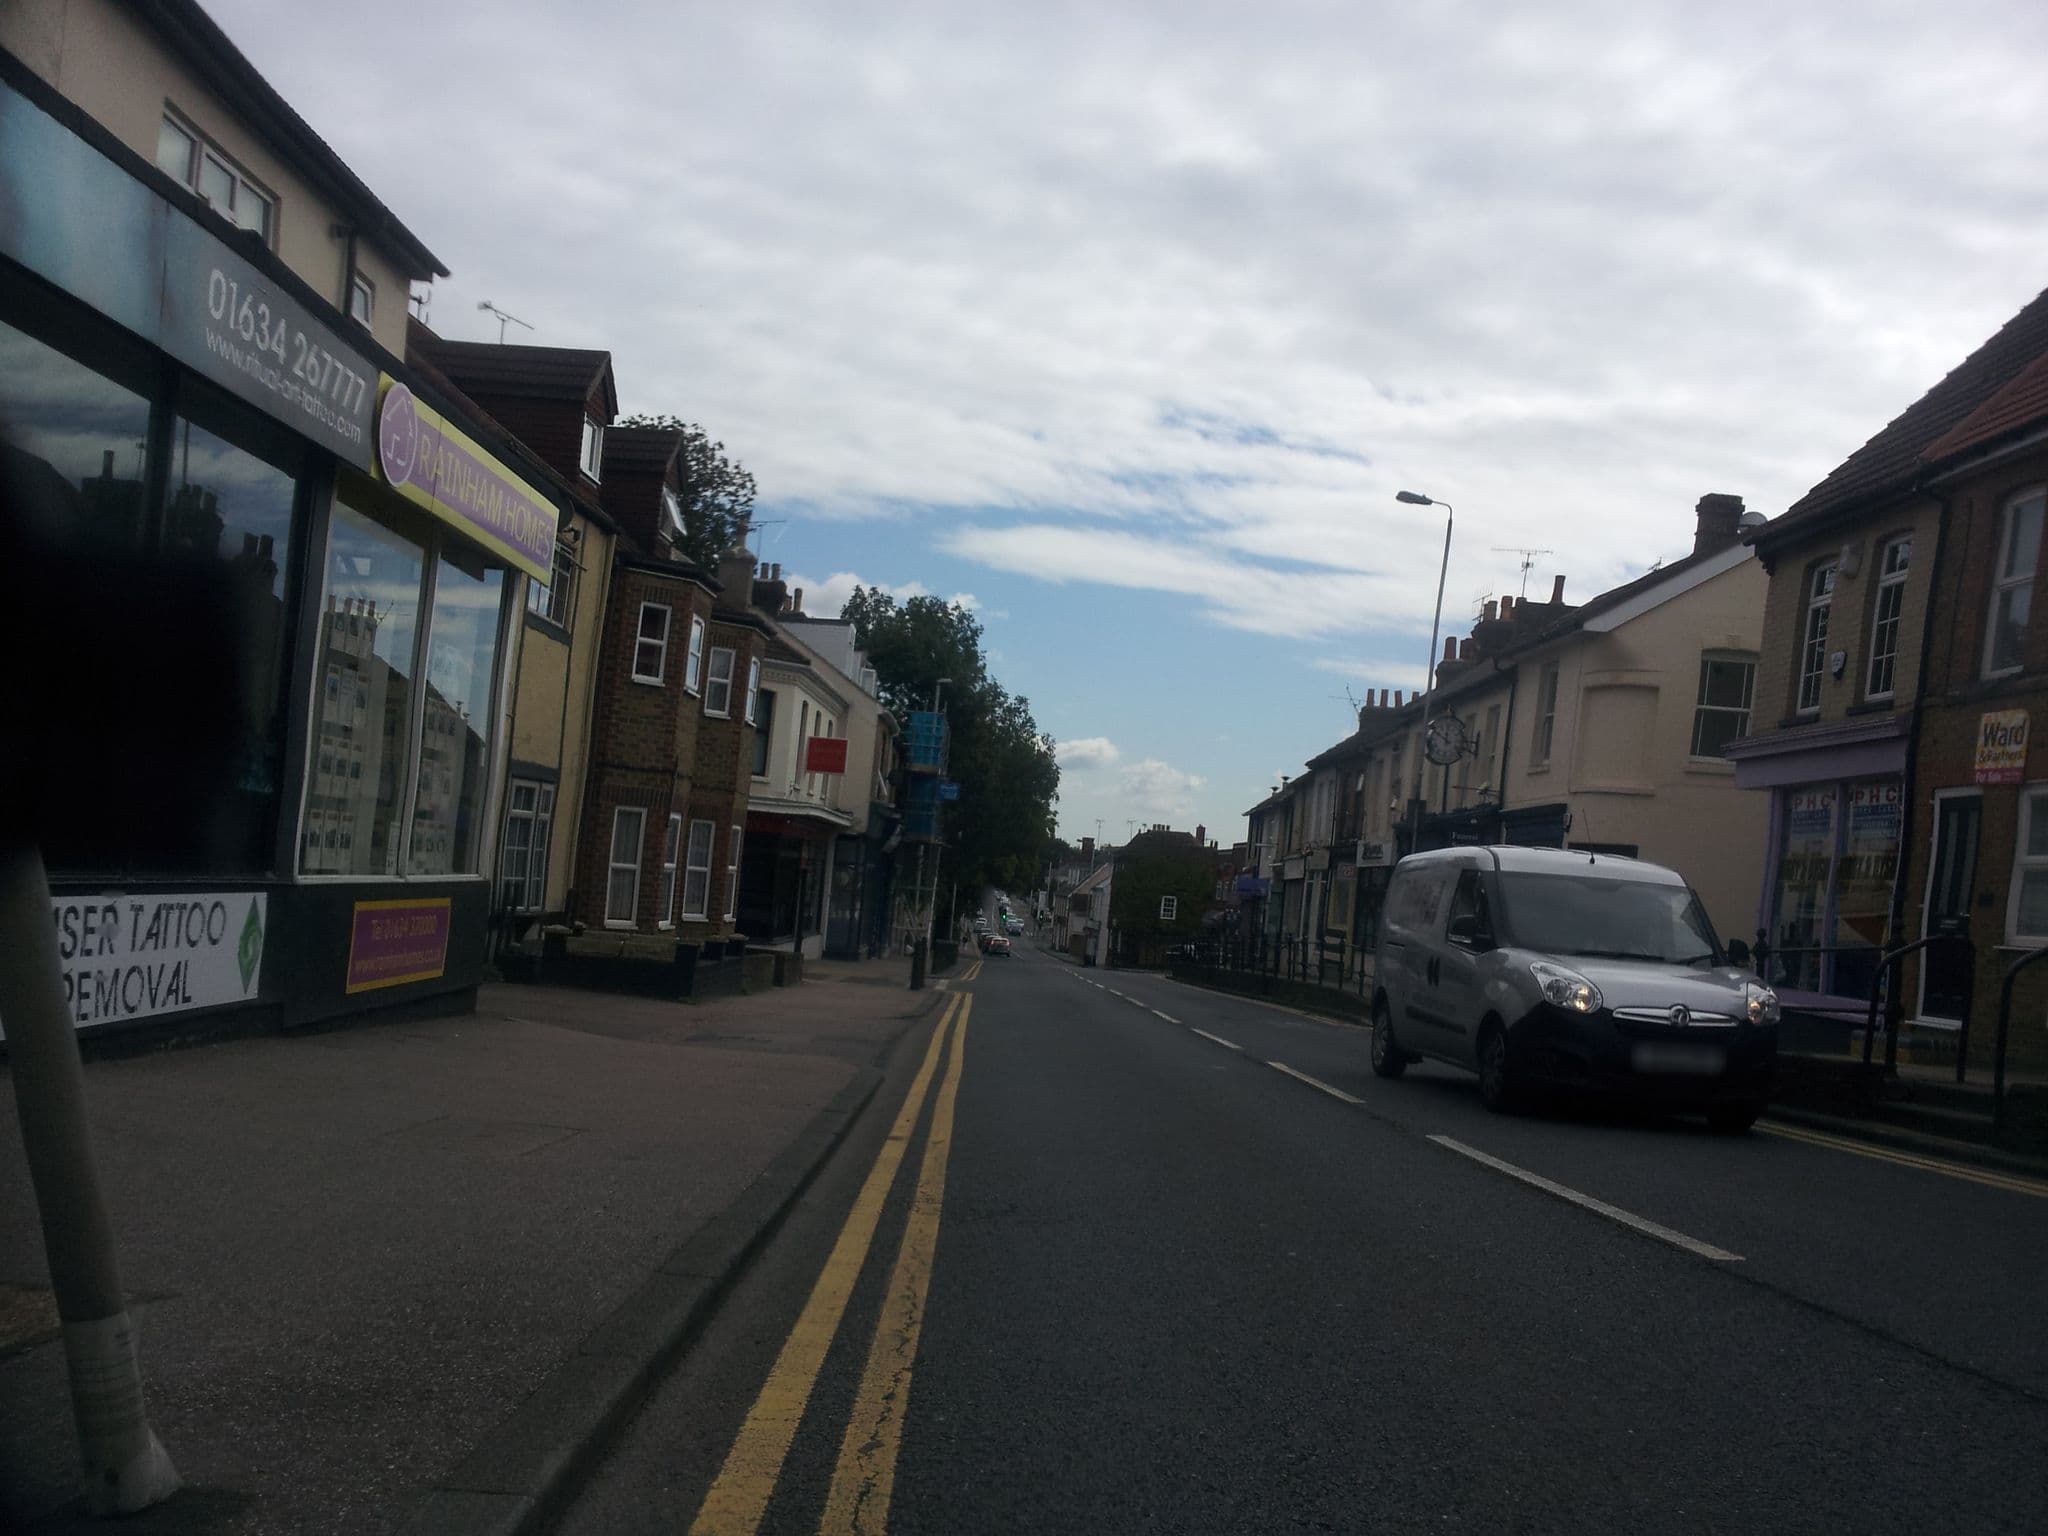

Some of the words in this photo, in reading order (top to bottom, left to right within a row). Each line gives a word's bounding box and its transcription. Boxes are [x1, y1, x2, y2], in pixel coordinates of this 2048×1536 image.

[208, 269, 287, 365] 01634
[291, 331, 366, 415] 267777
[419, 434, 504, 529] RAINHAM
[503, 500, 550, 560] HOMES
[1983, 719, 2026, 748] Ward
[129, 901, 226, 953] TATTOO
